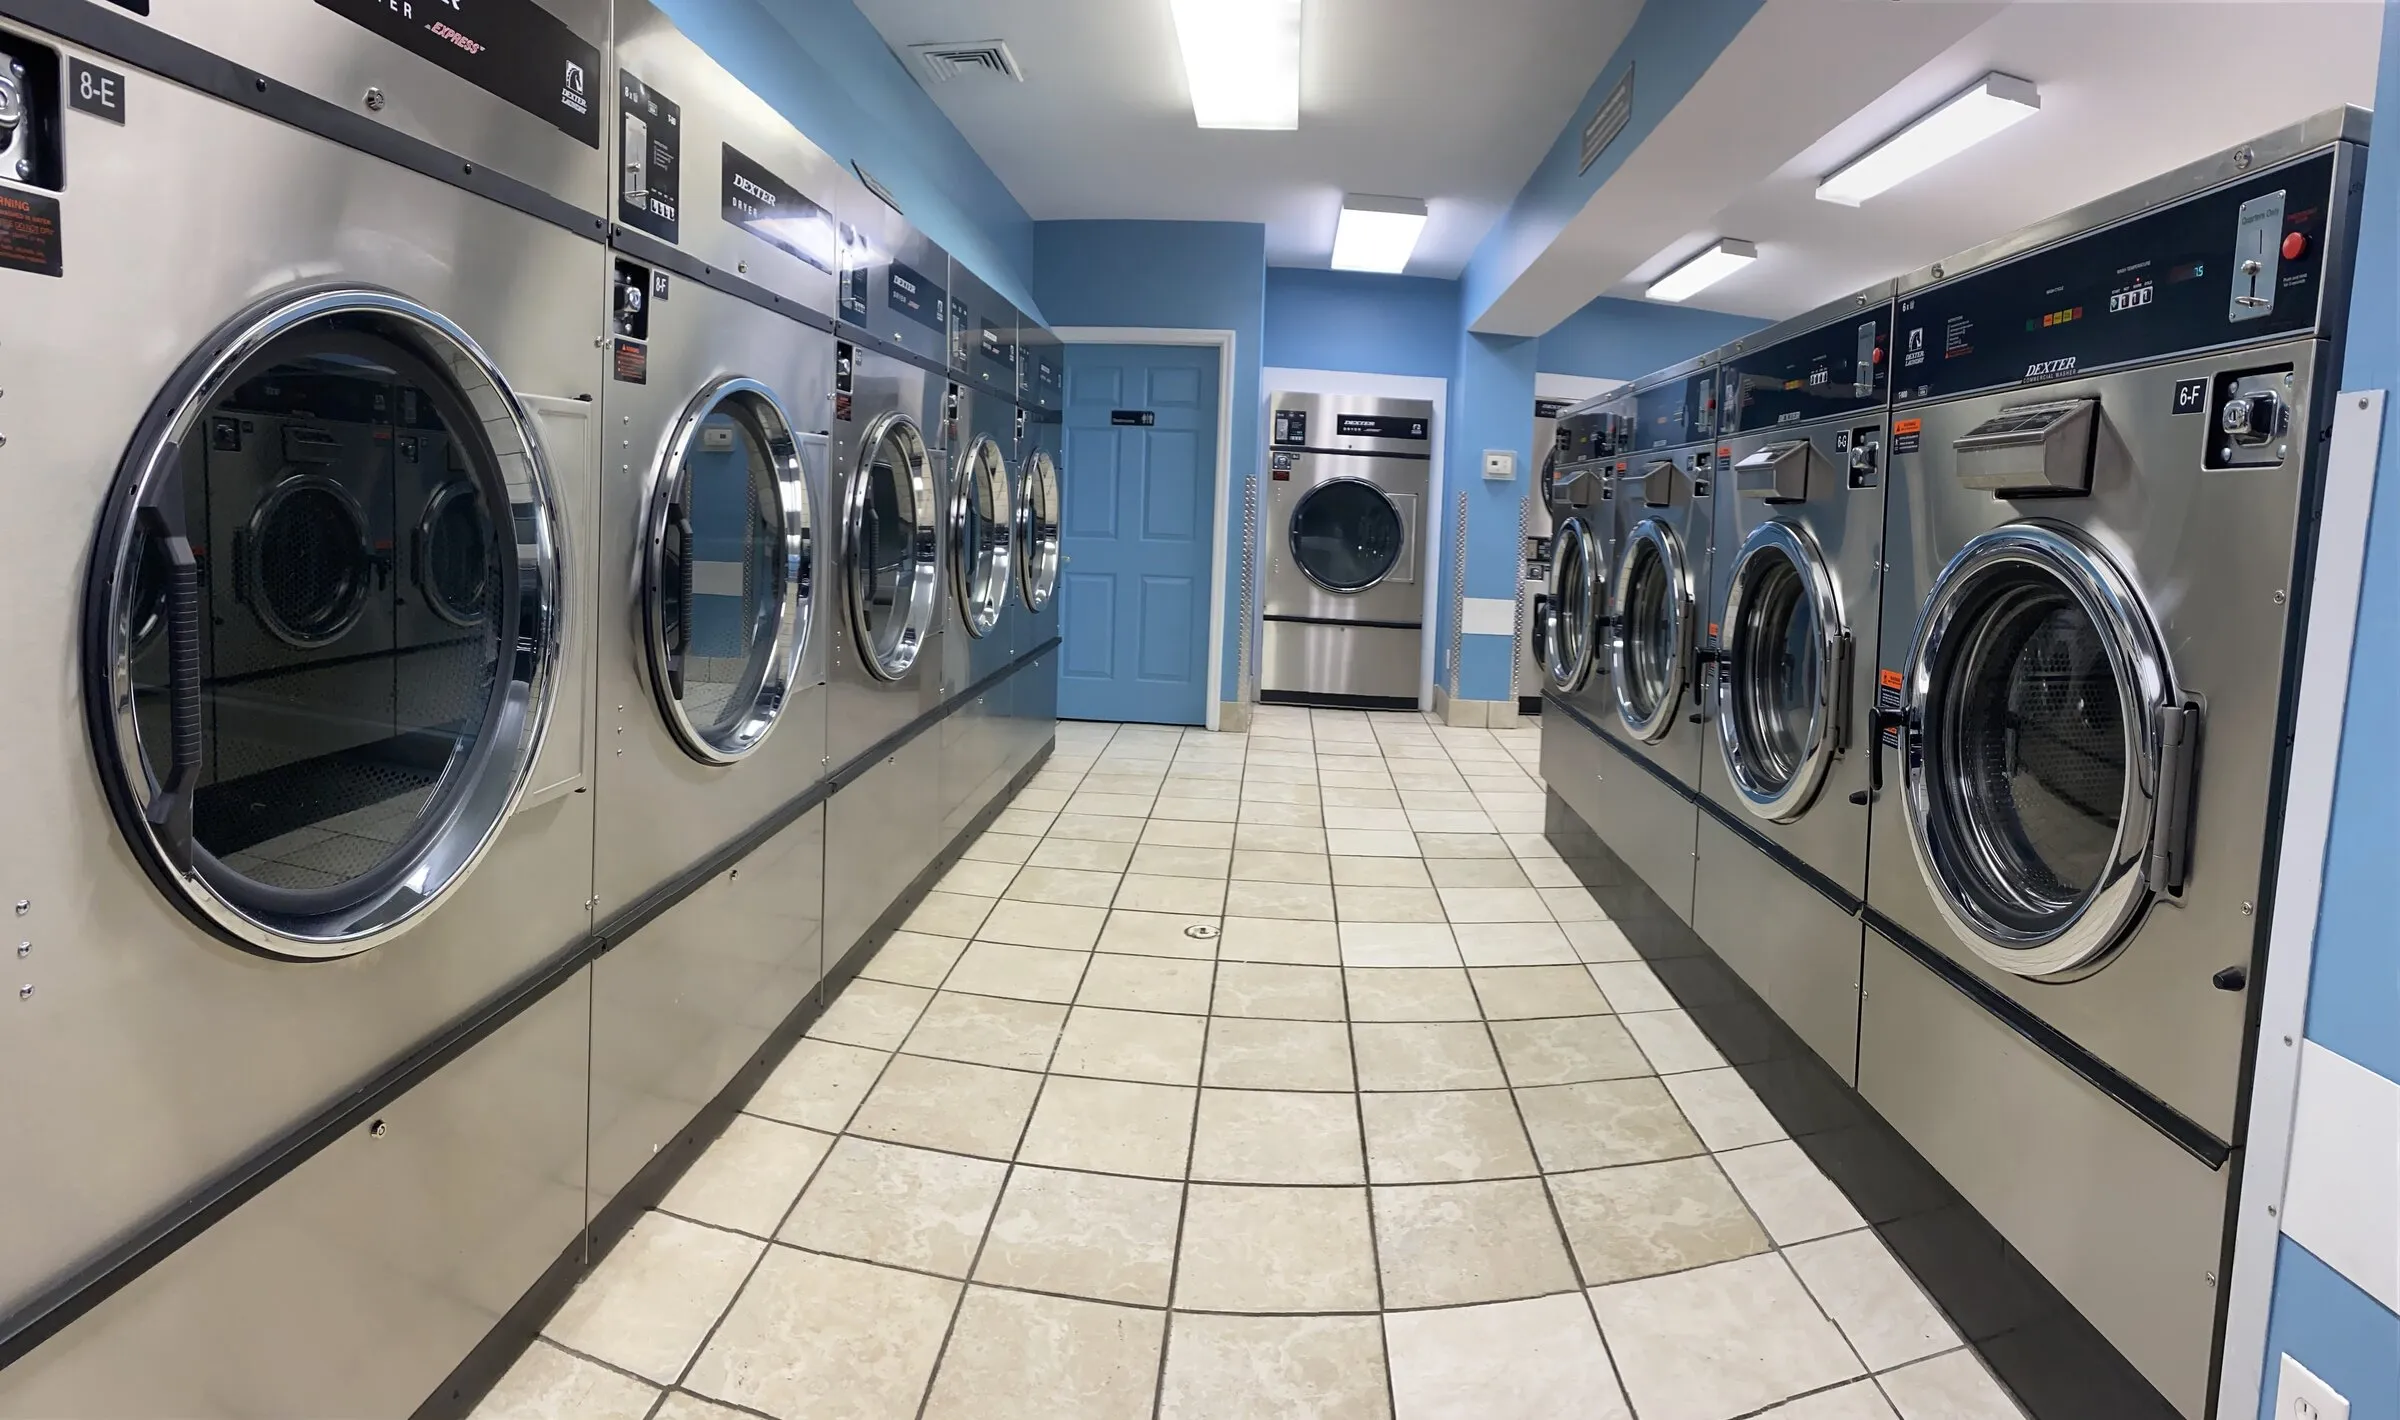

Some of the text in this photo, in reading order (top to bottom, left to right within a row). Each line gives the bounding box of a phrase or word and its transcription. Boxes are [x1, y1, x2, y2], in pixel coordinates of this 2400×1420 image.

[430, 21, 480, 54] EXPRESS
[80, 71, 116, 108] 8-E
[733, 173, 776, 207] DEXTER
[732, 197, 758, 219] DRYER
[2241, 212, 2265, 226] Quarters
[656, 276, 666, 293] 8-F
[893, 274, 916, 294] DEXTER
[1906, 350, 1925, 361] DEXTER
[2023, 368, 2077, 384] COMMERCIAL WASHER
[2025, 356, 2077, 378] DEXTER
[2180, 385, 2201, 406] 6-F
[1777, 411, 1800, 423] DEXTER
[1837, 433, 1847, 448] 6-G
